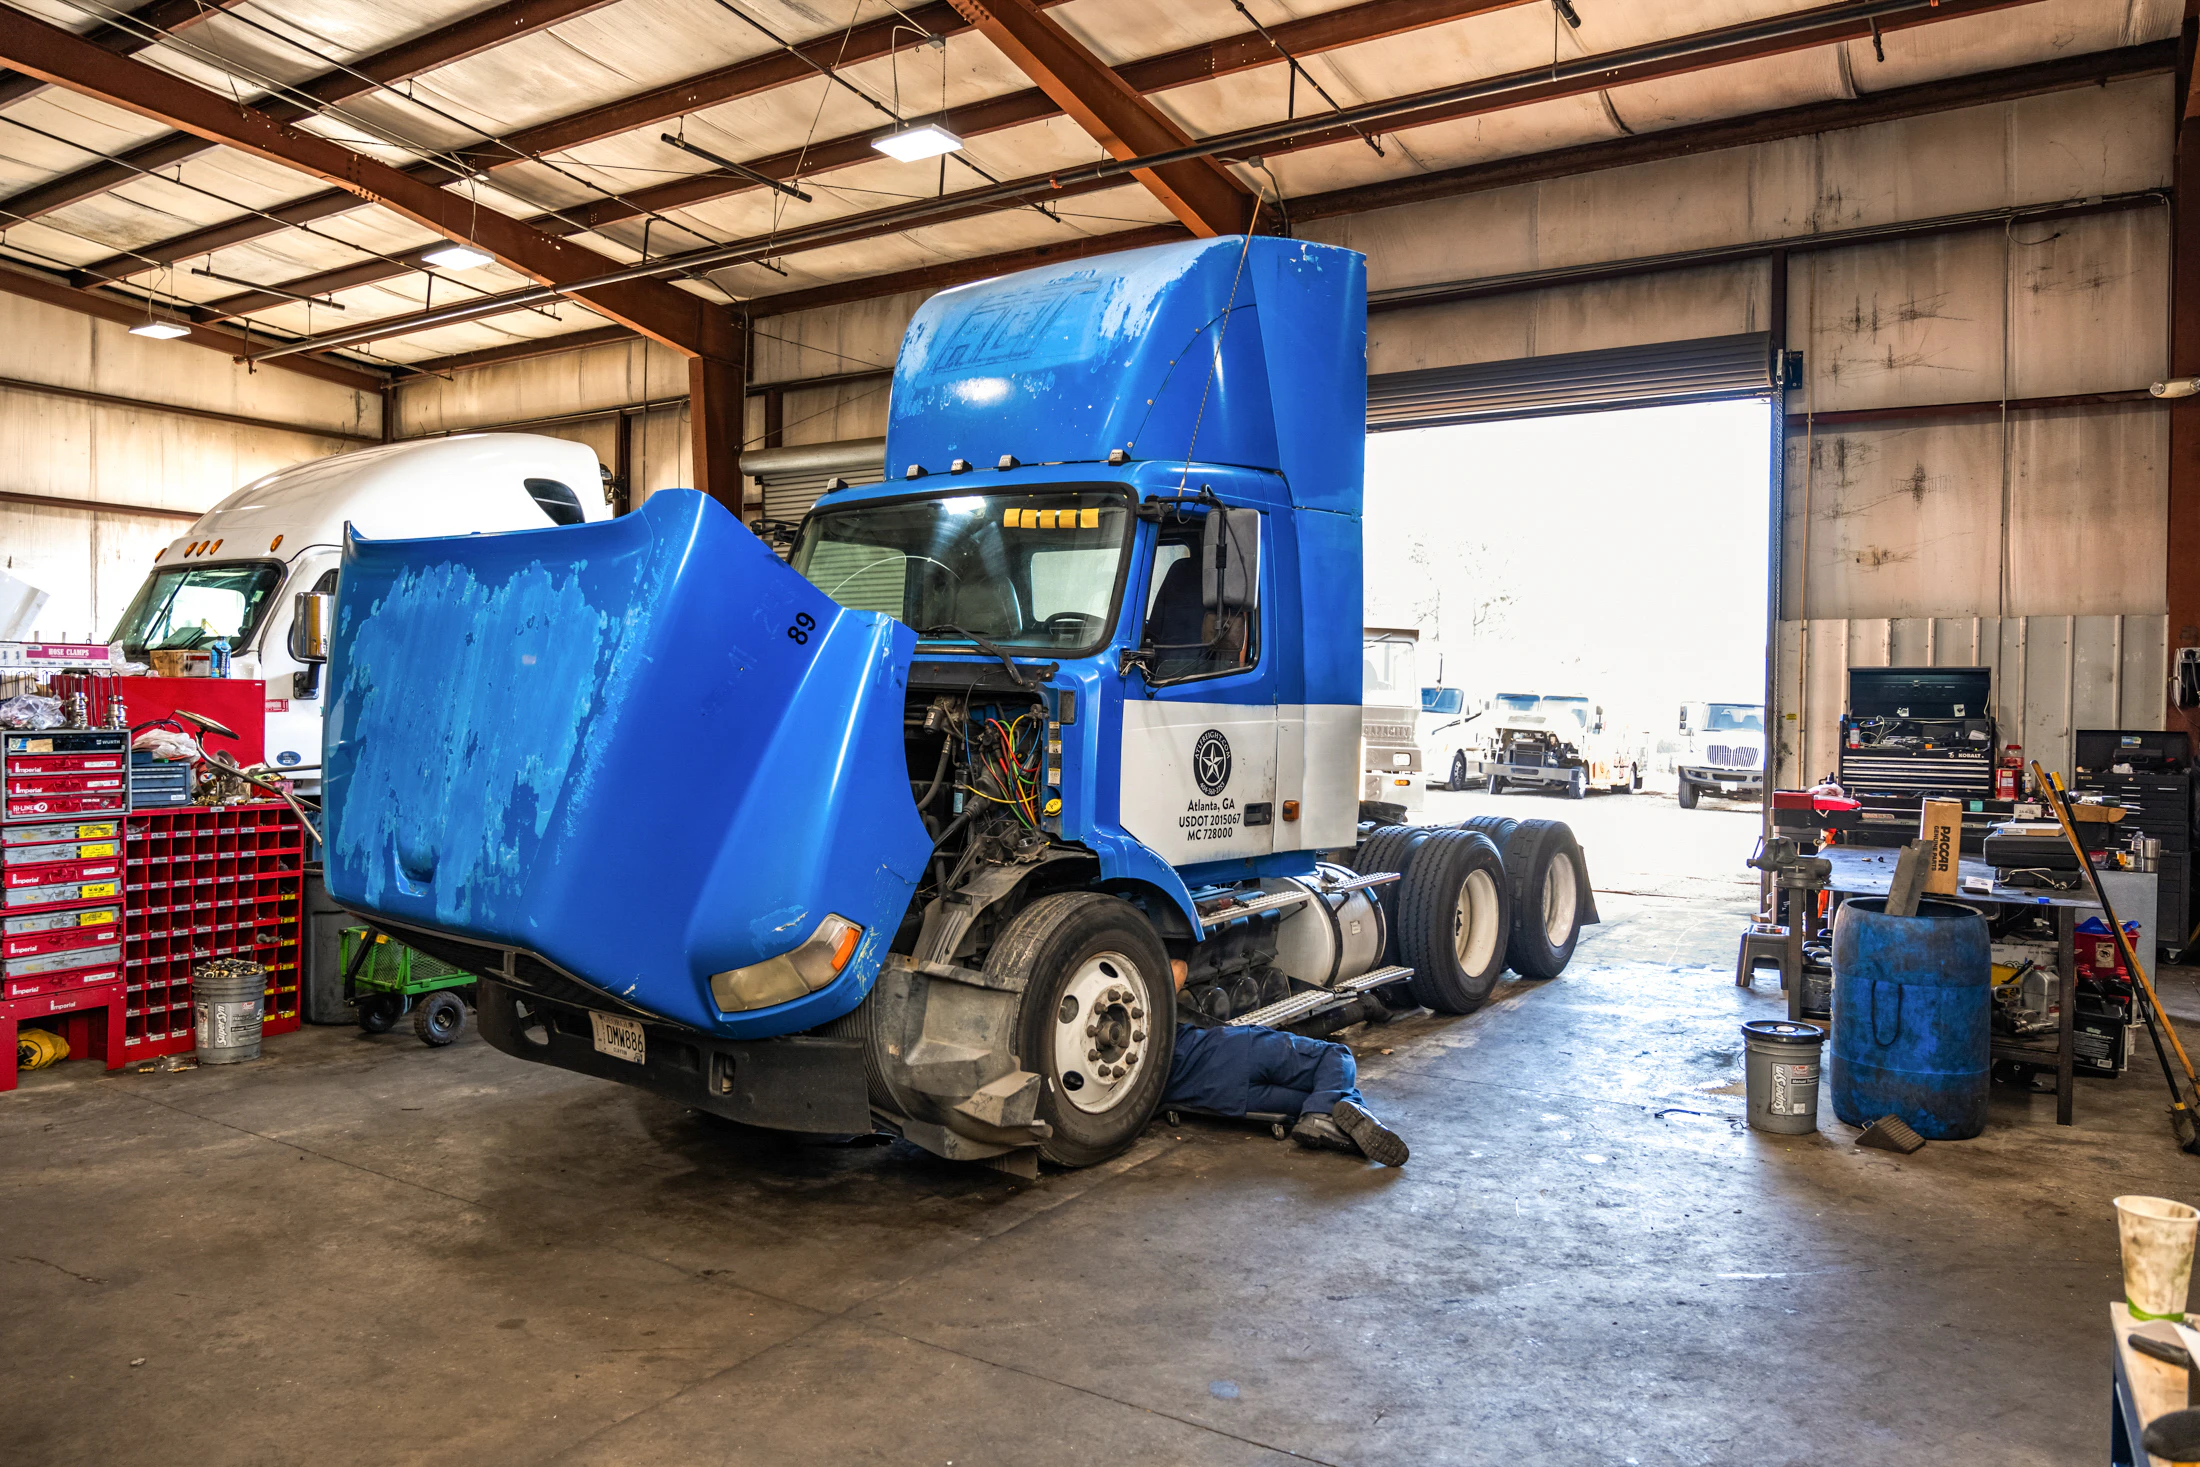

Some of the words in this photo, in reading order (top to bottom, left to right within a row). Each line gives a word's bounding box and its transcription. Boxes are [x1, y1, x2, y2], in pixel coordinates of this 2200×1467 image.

[788, 612, 816, 645] 89
[48, 648, 64, 656] HOSE
[66, 648, 89, 657] CLAMPS
[1187, 799, 1220, 813] Atlanta,
[1222, 798, 1236, 810] GA
[1179, 815, 1209, 827] USDOT
[1210, 813, 1241, 825] 2015067
[1187, 829, 1202, 841] MC
[1203, 827, 1233, 839] 728000
[1938, 825, 1950, 872] PACCAR
